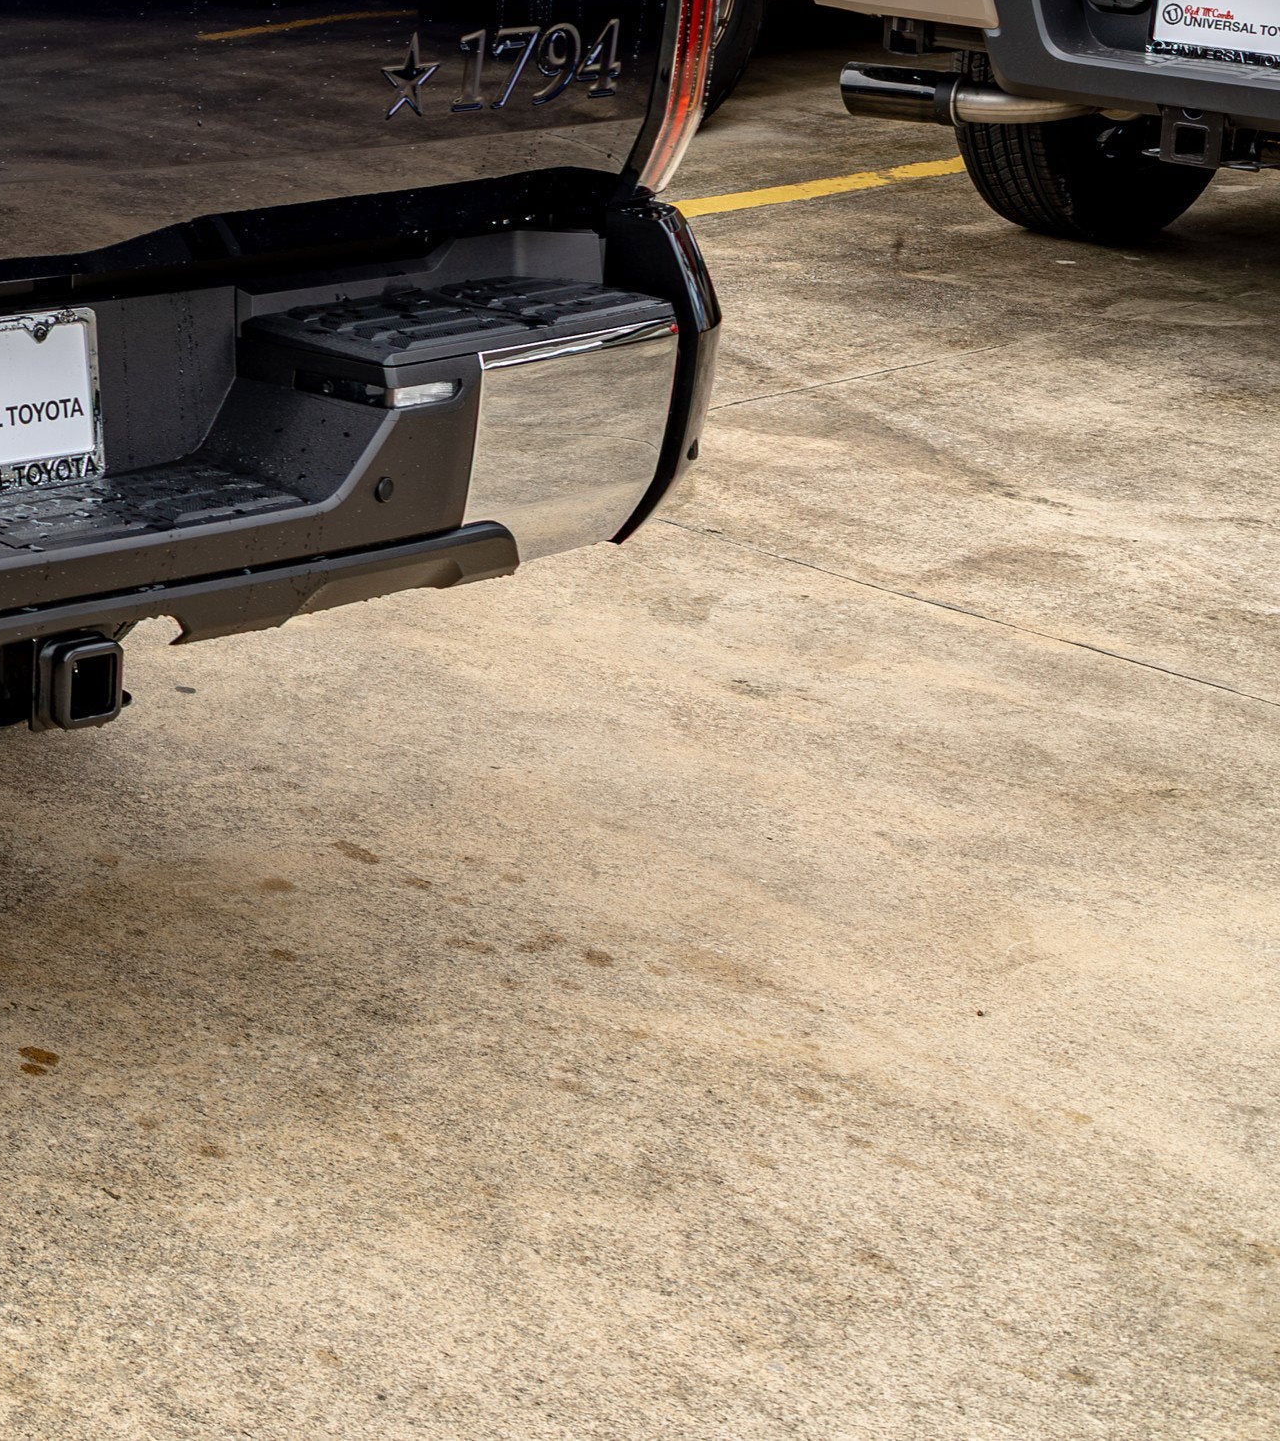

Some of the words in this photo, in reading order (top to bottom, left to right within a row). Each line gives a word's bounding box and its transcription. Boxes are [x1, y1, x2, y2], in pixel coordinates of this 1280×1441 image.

[1183, 16, 1257, 34] UNIVERSAL
[451, 18, 621, 112] 1794
[5, 396, 84, 424] TOYOTA
[9, 456, 99, 487] TOYOTA
